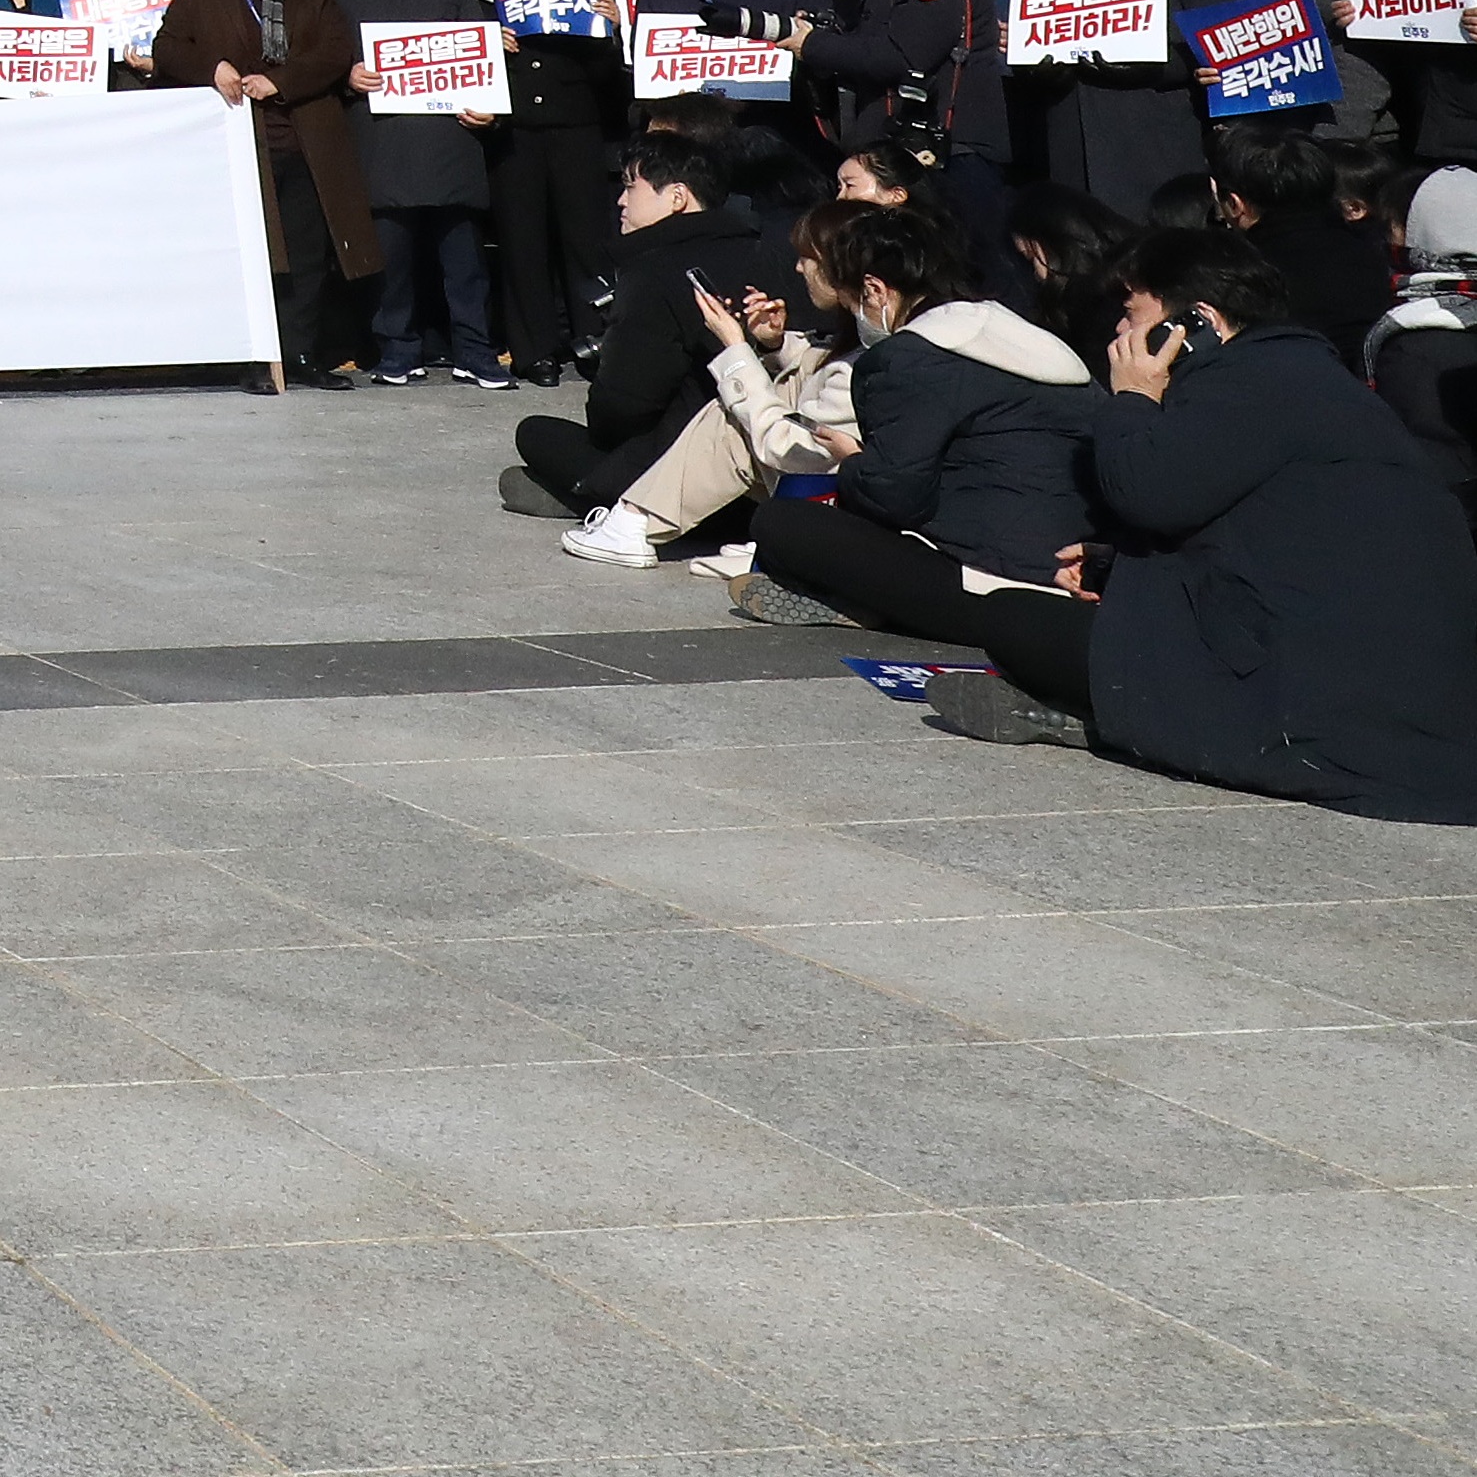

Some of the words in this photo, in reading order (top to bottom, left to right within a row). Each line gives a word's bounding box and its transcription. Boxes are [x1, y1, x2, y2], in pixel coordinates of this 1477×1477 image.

[1026, 5, 1151, 47] 사퇴하라!
[1201, 0, 1305, 64] 내란행위
[375, 29, 482, 71] 윤석열은
[651, 54, 779, 83] 사퇴하라!
[1220, 39, 1323, 98] 즉각수사!
[383, 62, 493, 98] 사퇴하라!
[427, 100, 453, 112] 민주당
